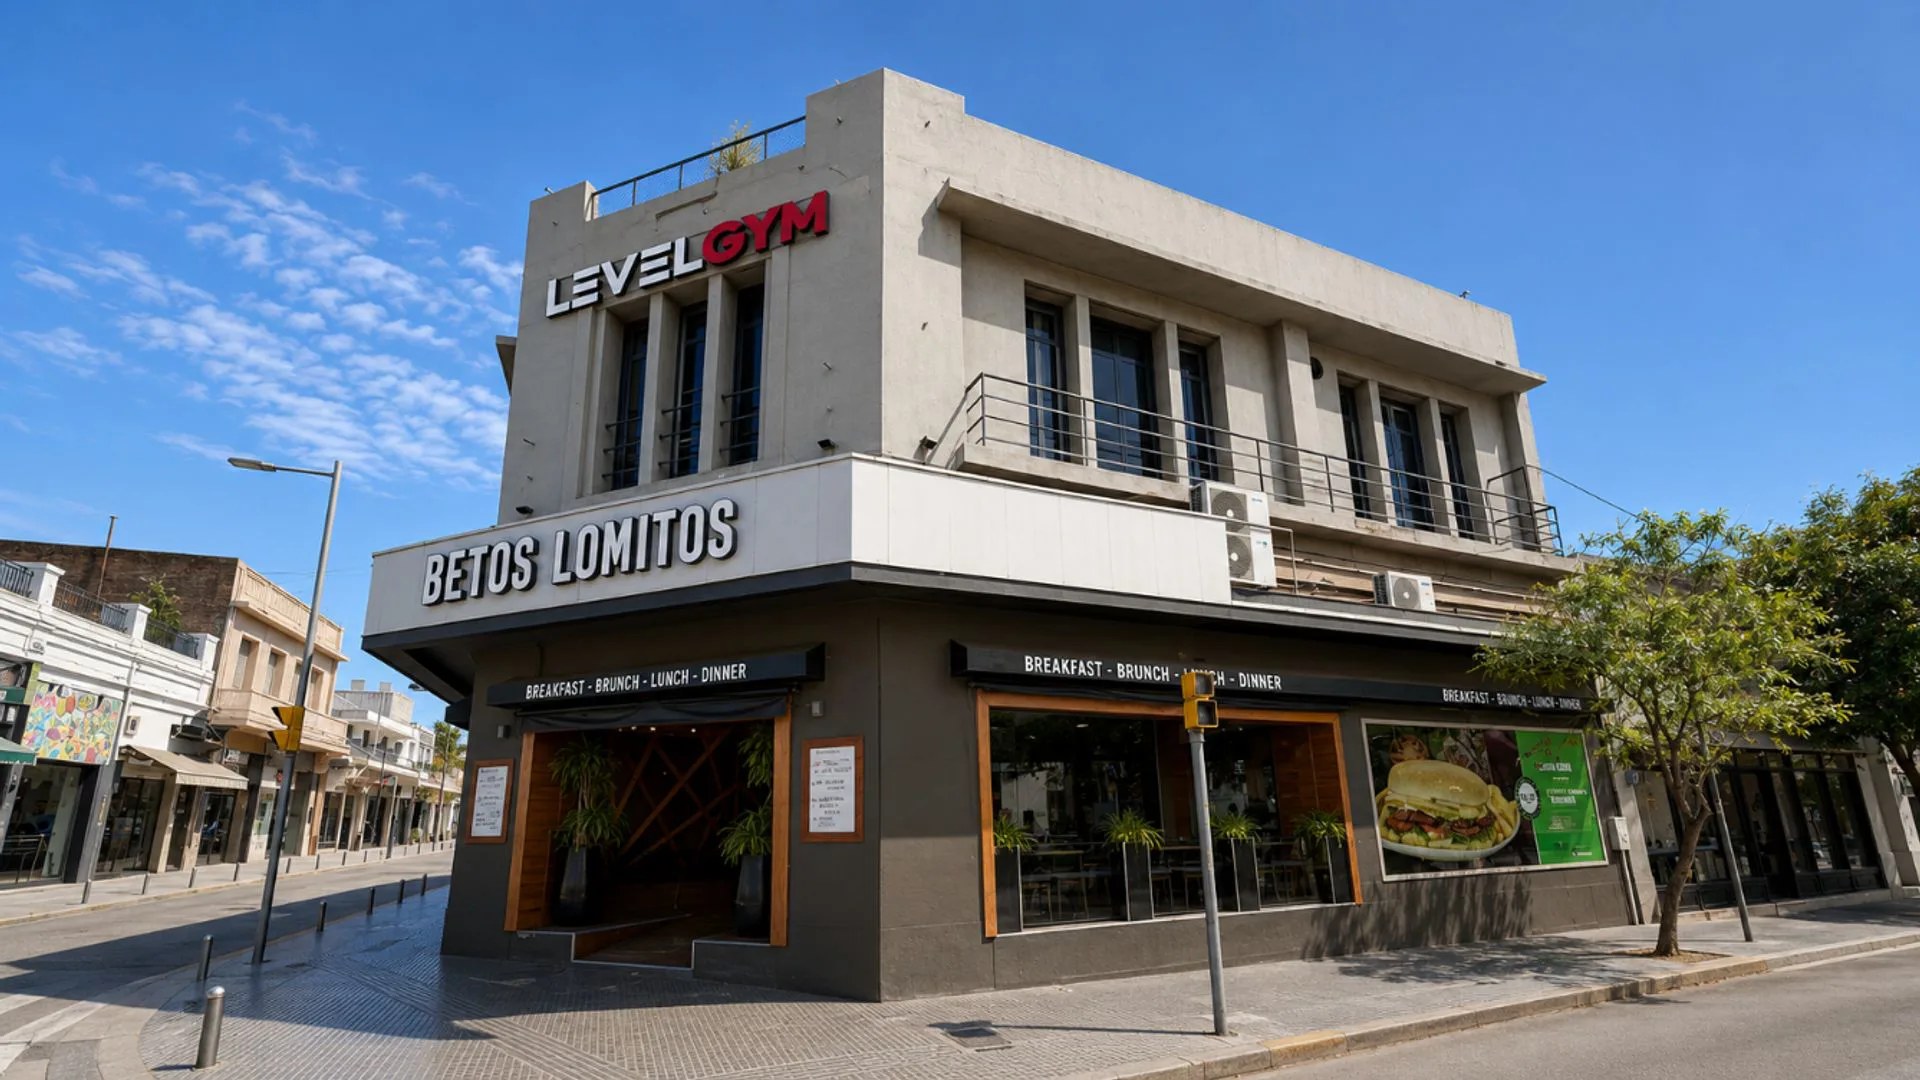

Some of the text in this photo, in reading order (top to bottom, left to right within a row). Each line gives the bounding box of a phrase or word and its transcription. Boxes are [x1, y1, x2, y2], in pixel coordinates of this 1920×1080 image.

[422, 497, 738, 606] BETOS LOMITOS
[525, 663, 747, 700] BREAKFAST BRUNCH LUNCH DINNER
[1024, 655, 1102, 677] BREAKFAST
[1117, 663, 1170, 682] BRUNCH
[1238, 672, 1282, 690] DINNER
[1442, 688, 1489, 704] BREAKFAST
